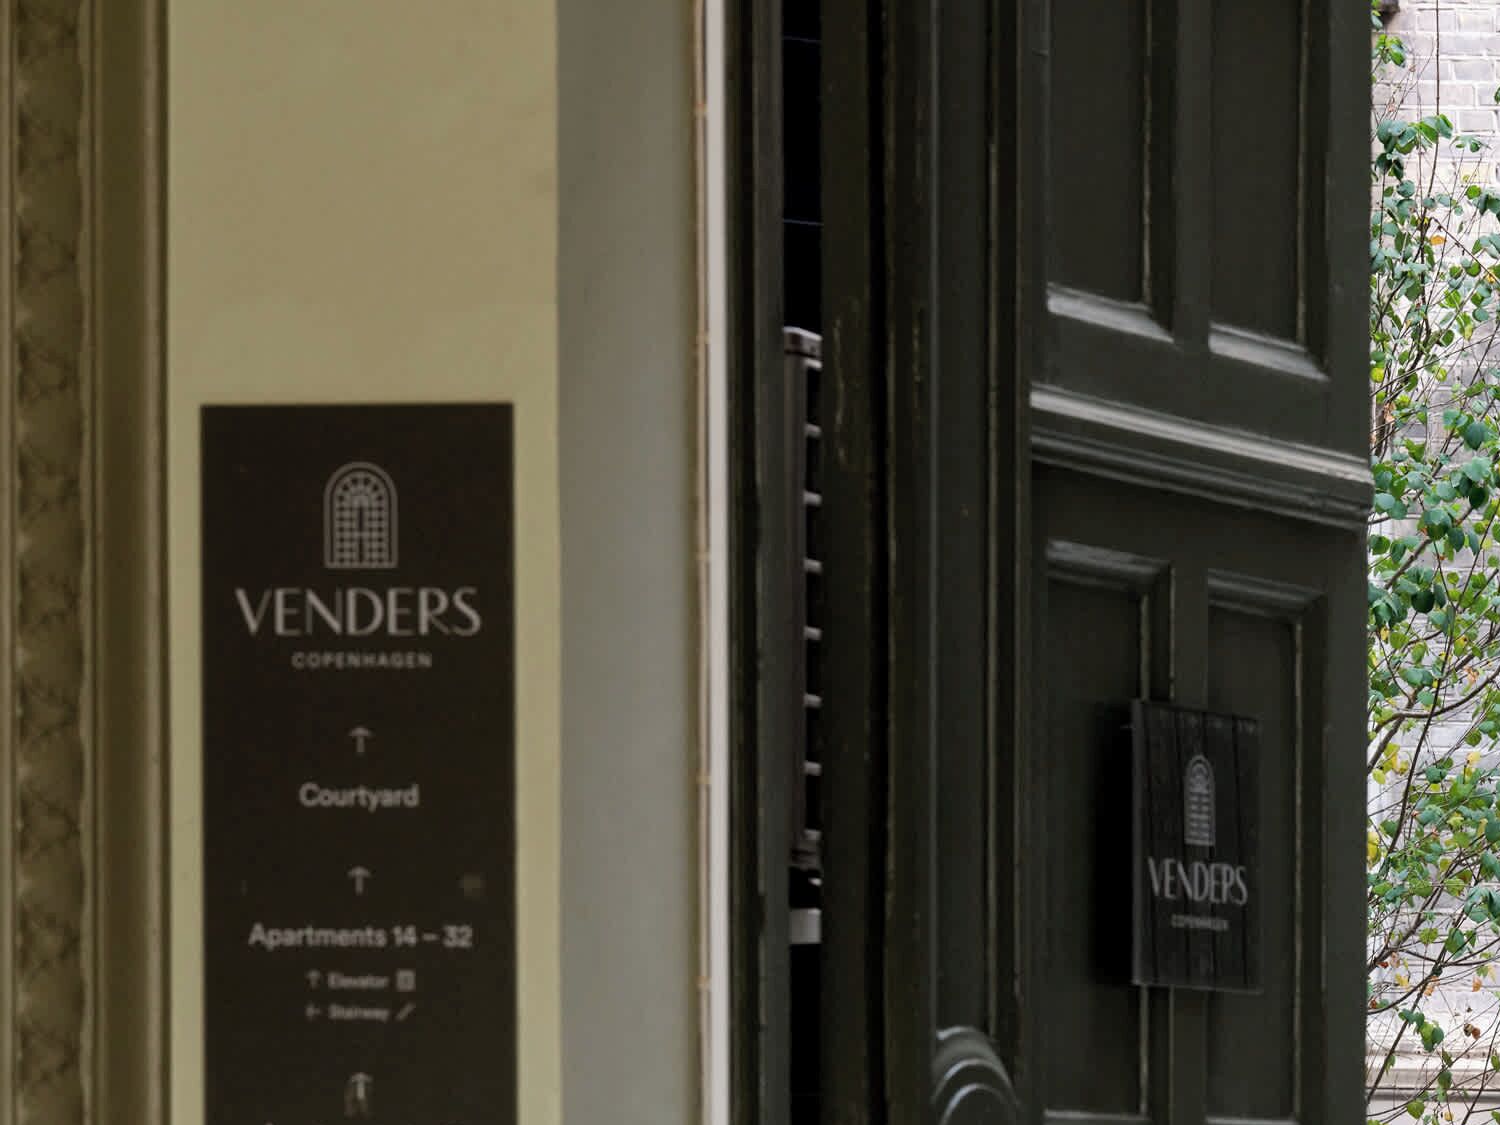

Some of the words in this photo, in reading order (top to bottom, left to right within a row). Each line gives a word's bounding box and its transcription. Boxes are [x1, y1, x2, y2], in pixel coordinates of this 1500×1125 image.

[234, 586, 482, 637] VENDERS
[290, 651, 433, 669] COPENHAGEN
[299, 782, 420, 813] Courtyard
[1147, 855, 1249, 906] VENDERS
[249, 922, 387, 950] Apartments
[392, 924, 417, 947] 14
[442, 924, 474, 947] 32
